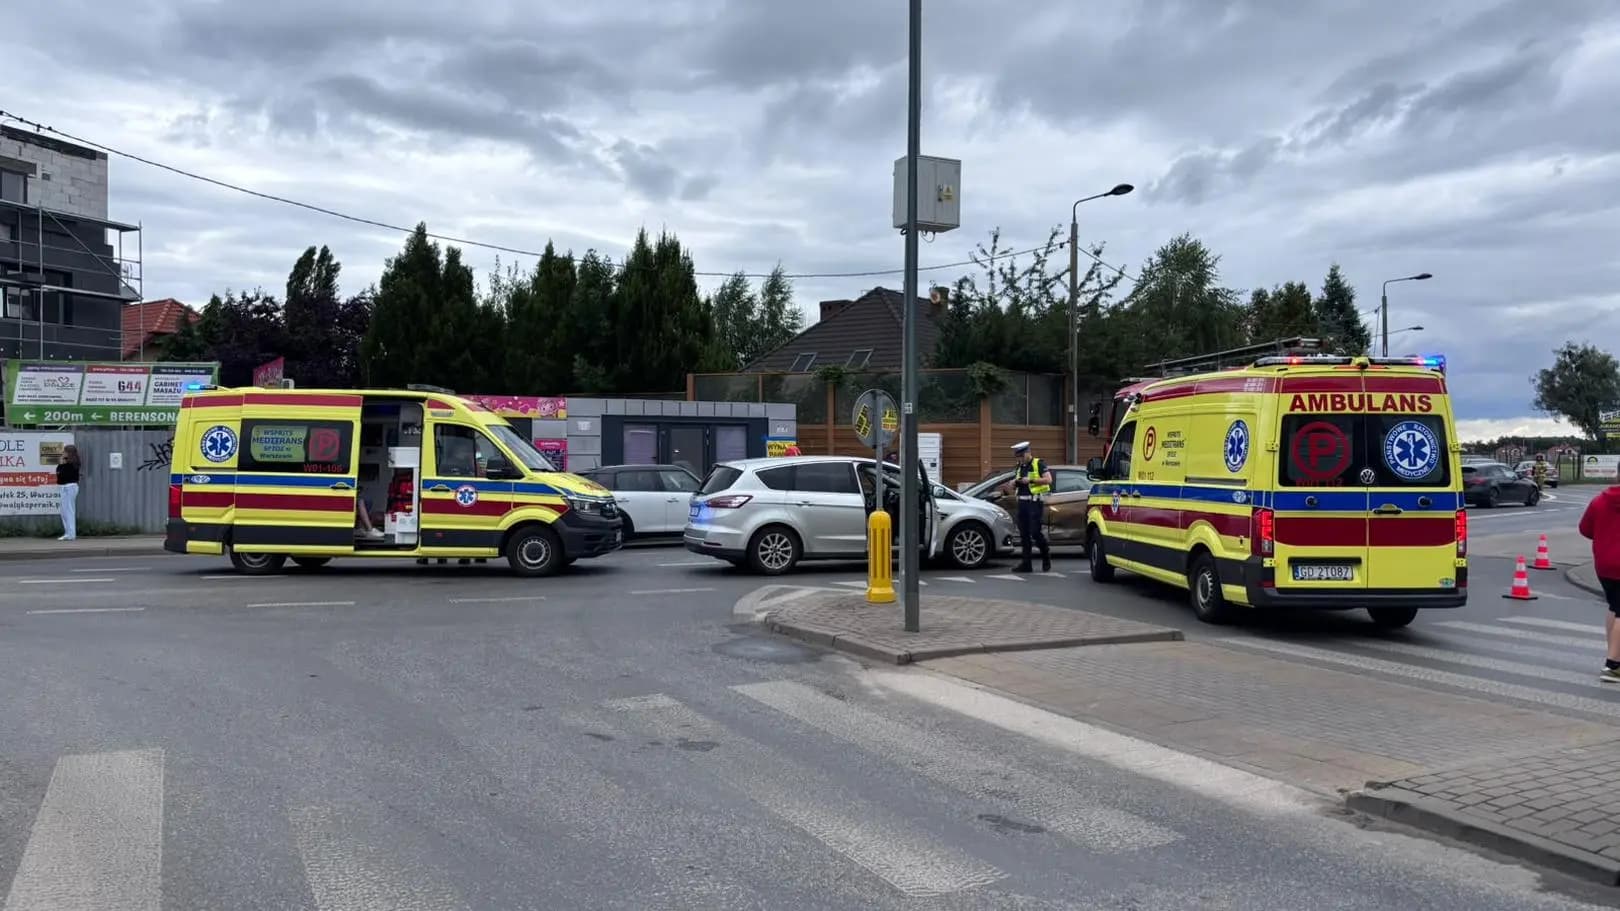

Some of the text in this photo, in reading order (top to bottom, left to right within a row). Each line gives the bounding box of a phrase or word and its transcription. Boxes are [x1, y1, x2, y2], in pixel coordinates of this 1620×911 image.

[118, 380, 141, 391] 644
[1289, 393, 1432, 412] AMBULANS
[44, 411, 83, 421] 200m
[110, 411, 179, 422] BERENSON
